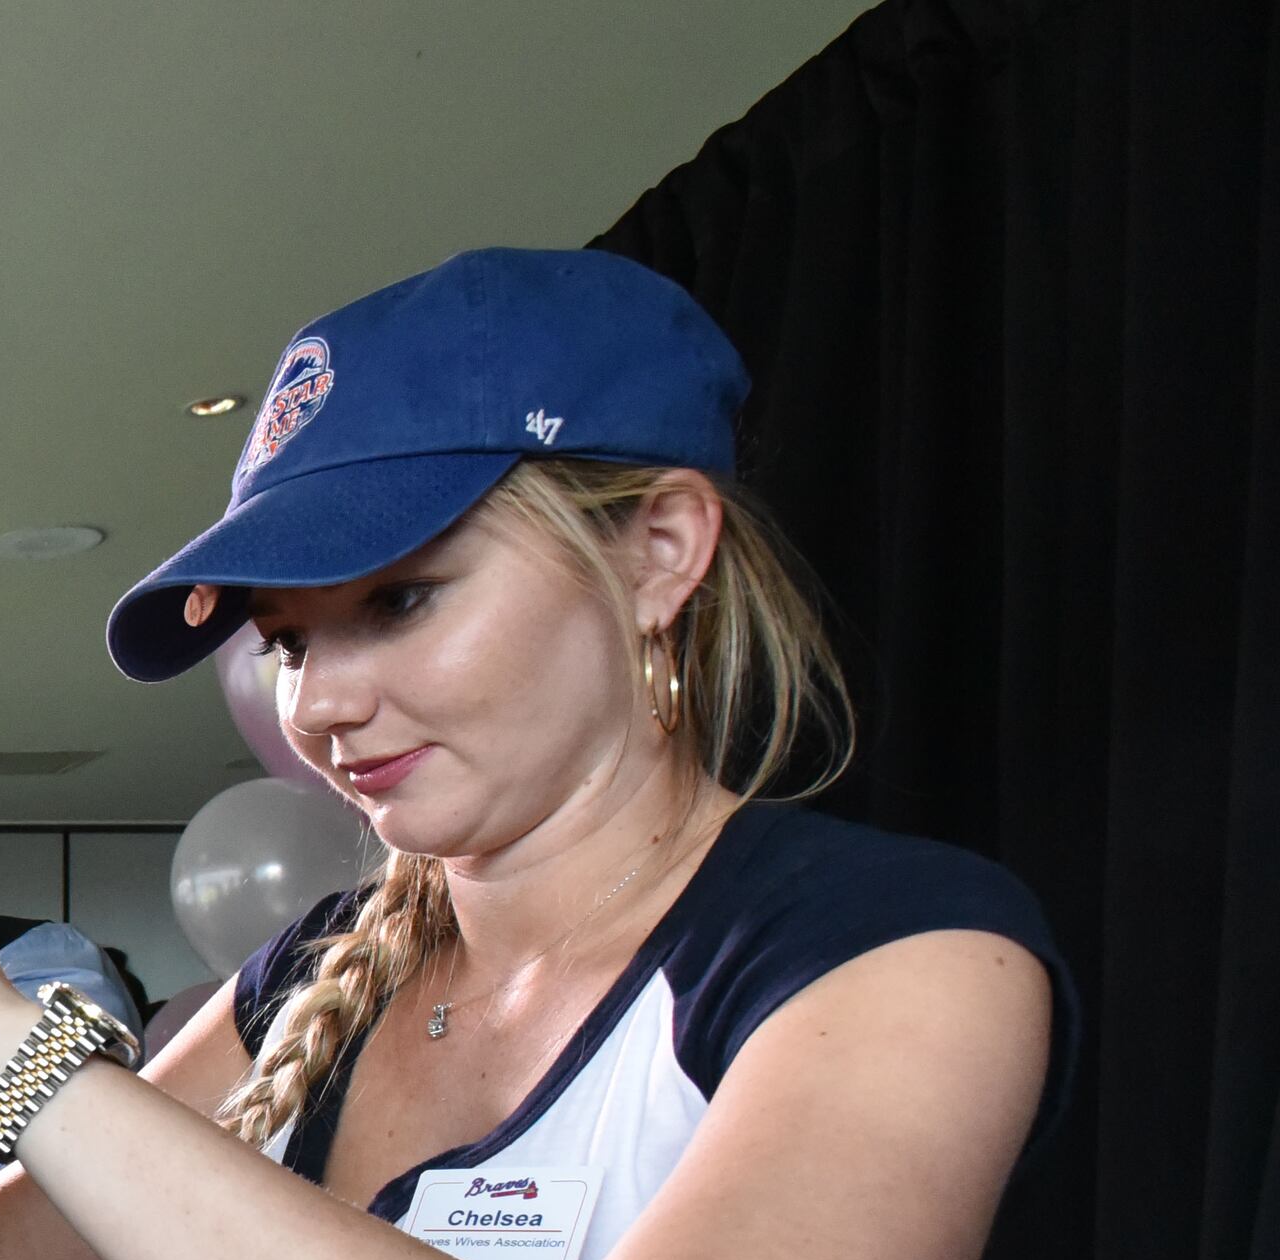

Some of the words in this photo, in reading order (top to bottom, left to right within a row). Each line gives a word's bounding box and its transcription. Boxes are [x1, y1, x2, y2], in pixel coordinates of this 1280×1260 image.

[272, 373, 331, 419] STAR
[464, 1177, 531, 1199] Braves
[447, 1209, 543, 1227] Chelsea
[421, 1236, 451, 1247] aves
[455, 1236, 490, 1248] Wives
[493, 1236, 566, 1249] Association
